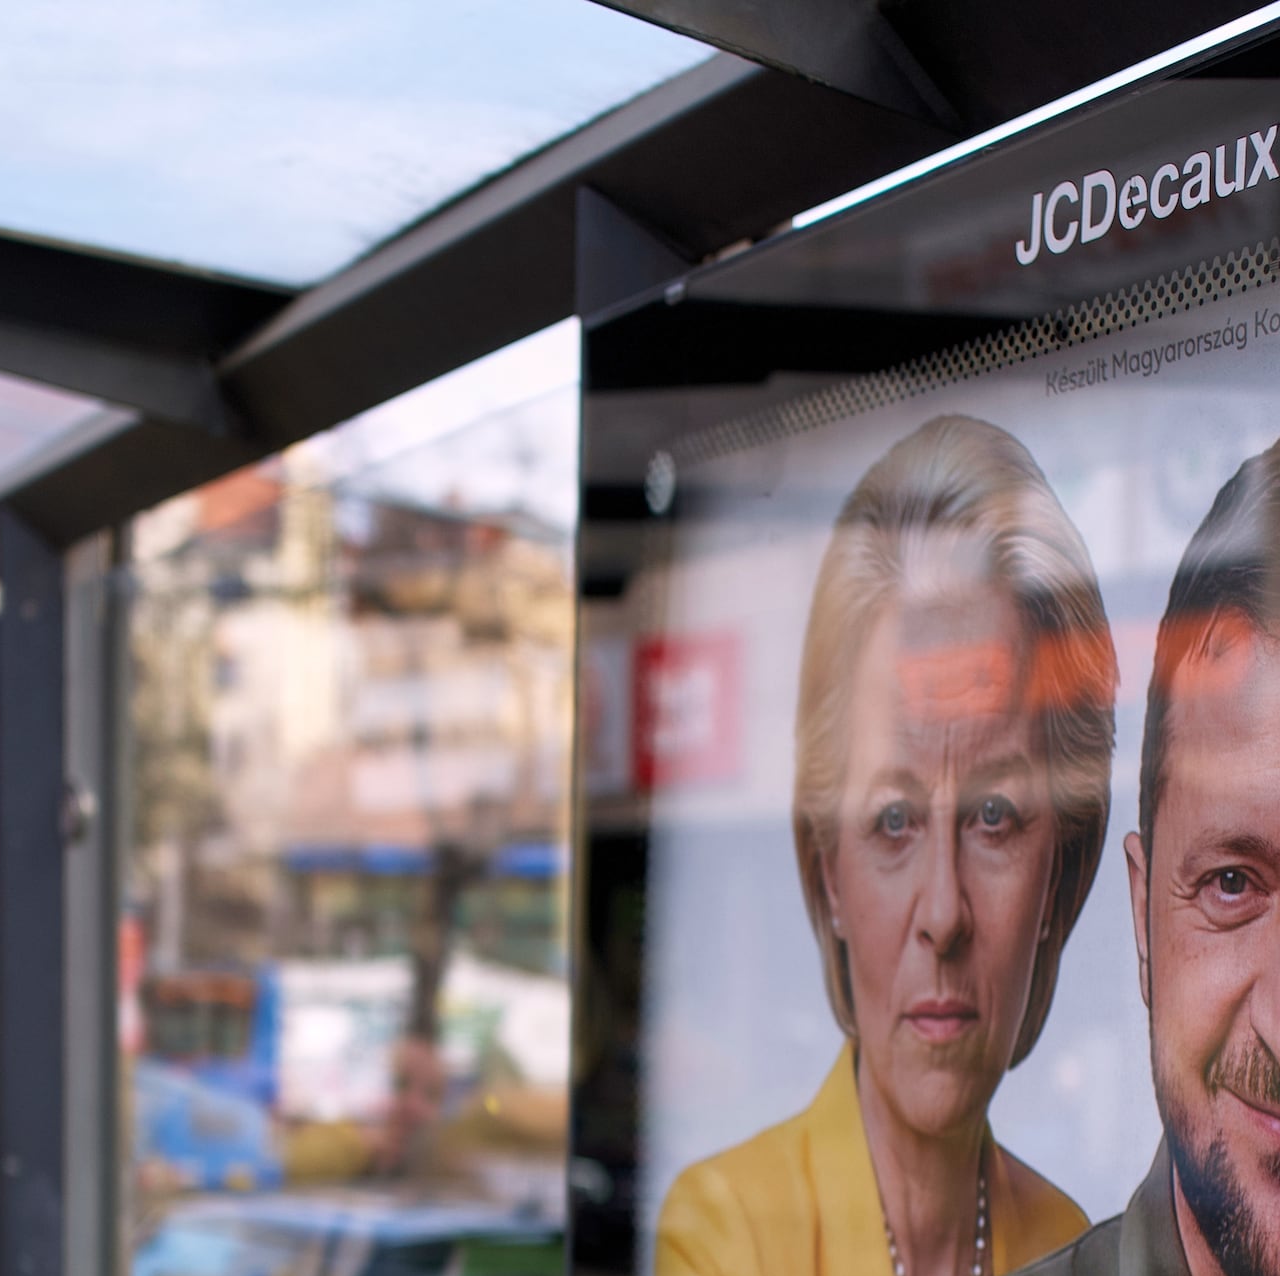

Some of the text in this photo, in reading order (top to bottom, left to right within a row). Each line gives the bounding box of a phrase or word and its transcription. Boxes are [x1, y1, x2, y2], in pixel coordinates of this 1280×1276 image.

[1015, 123, 1280, 265] JCDecaux
[1045, 358, 1109, 397] Készült
[1111, 317, 1248, 377] Magyarország
